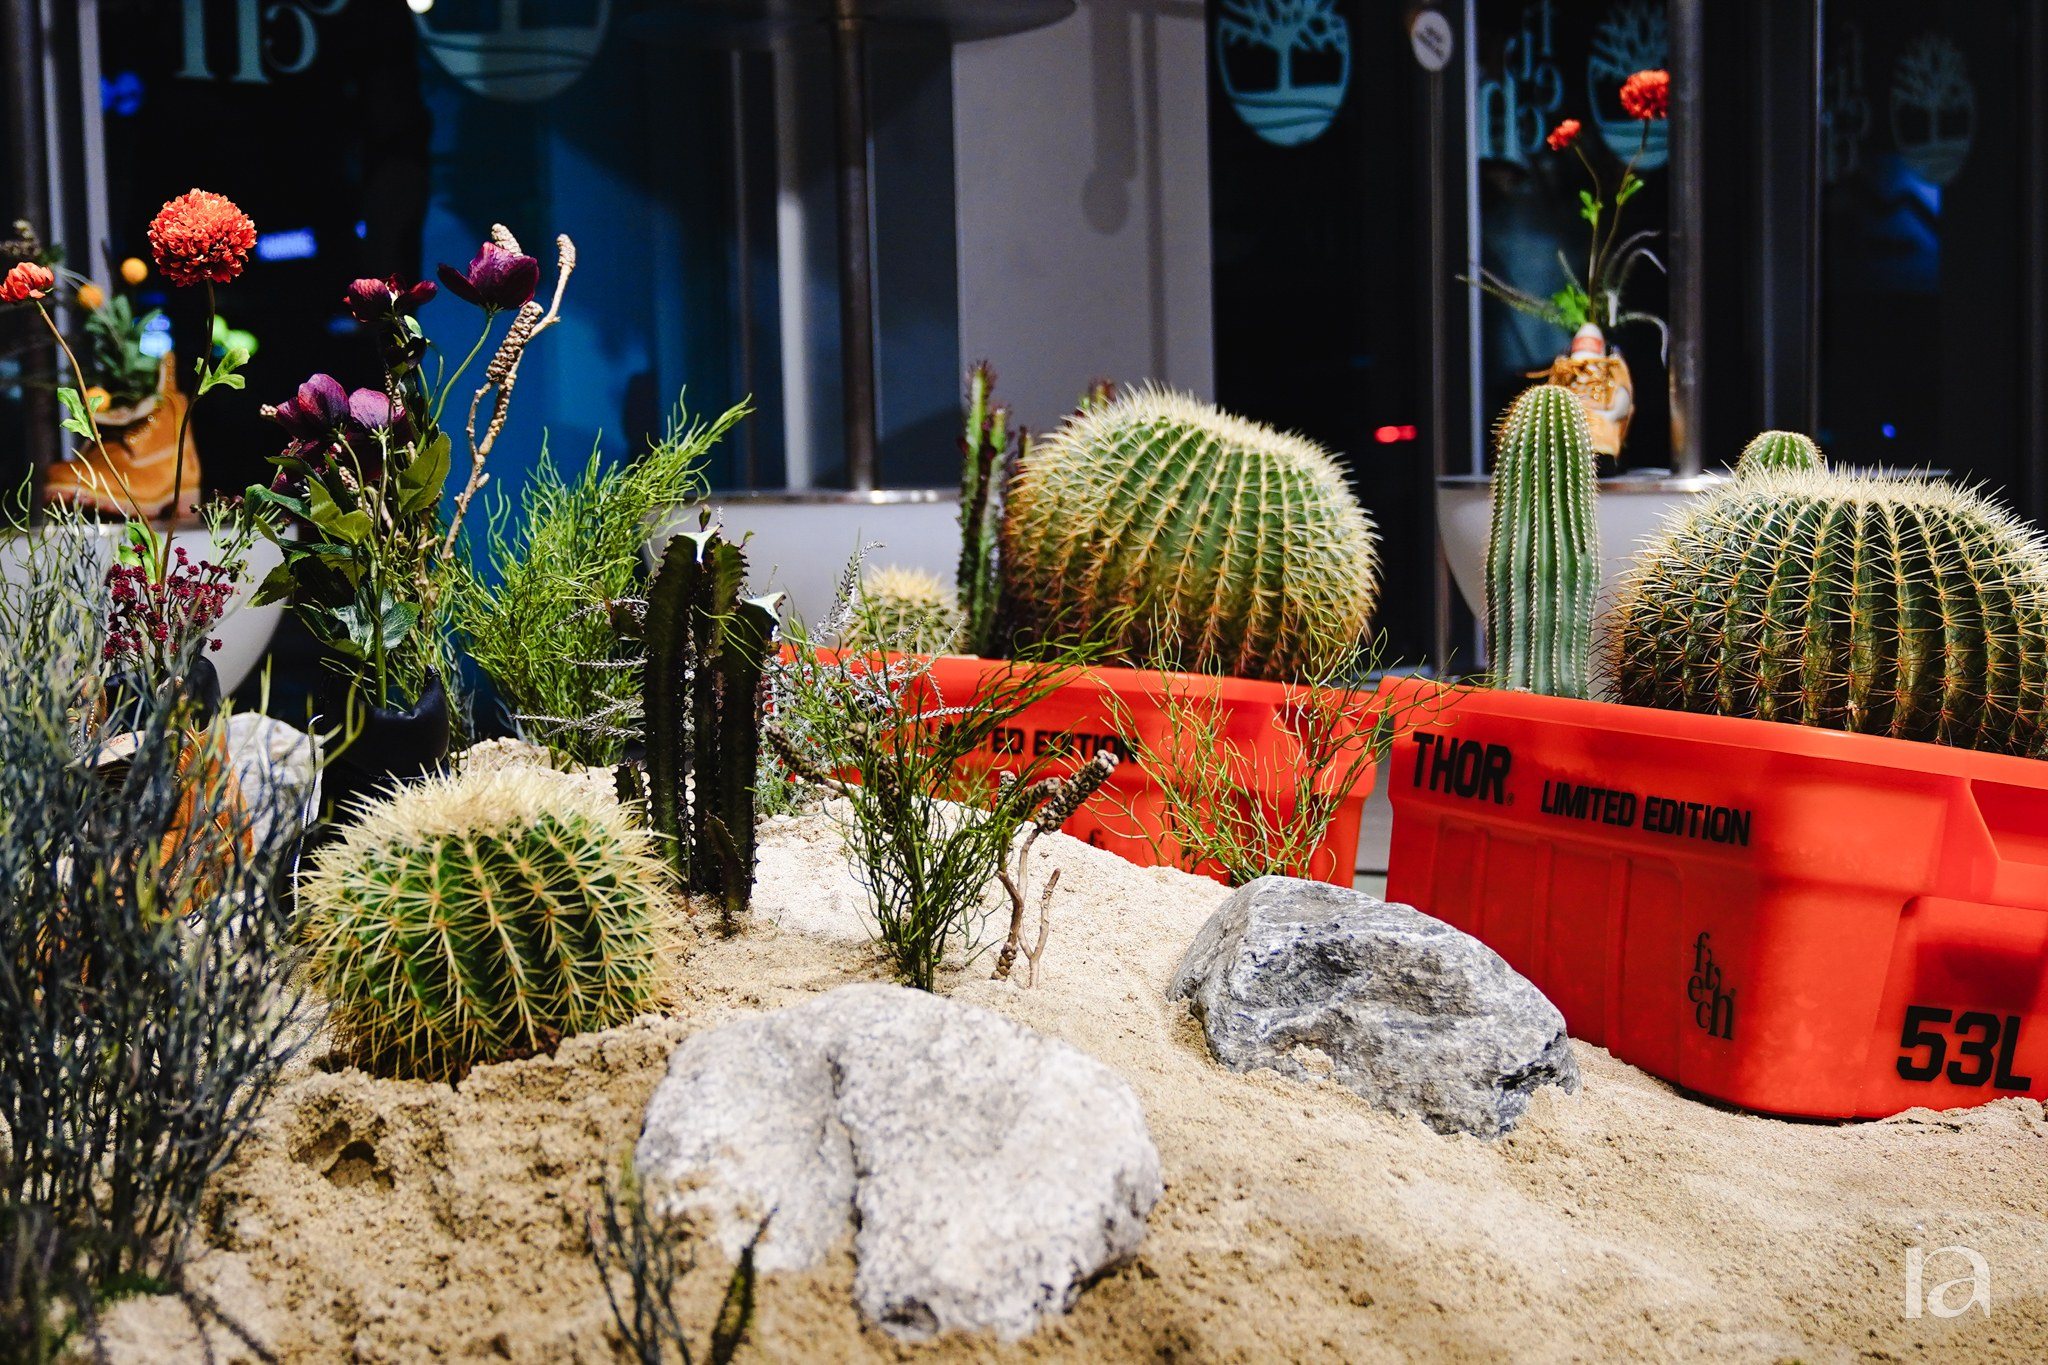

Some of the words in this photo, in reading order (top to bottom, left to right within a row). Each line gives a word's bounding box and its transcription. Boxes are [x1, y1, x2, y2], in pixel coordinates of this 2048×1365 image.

[1413, 731, 1511, 805] THOR
[1540, 780, 1637, 827] LIMITED
[1643, 795, 1750, 847] EDITION
[1896, 1005, 2032, 1091] 53L
